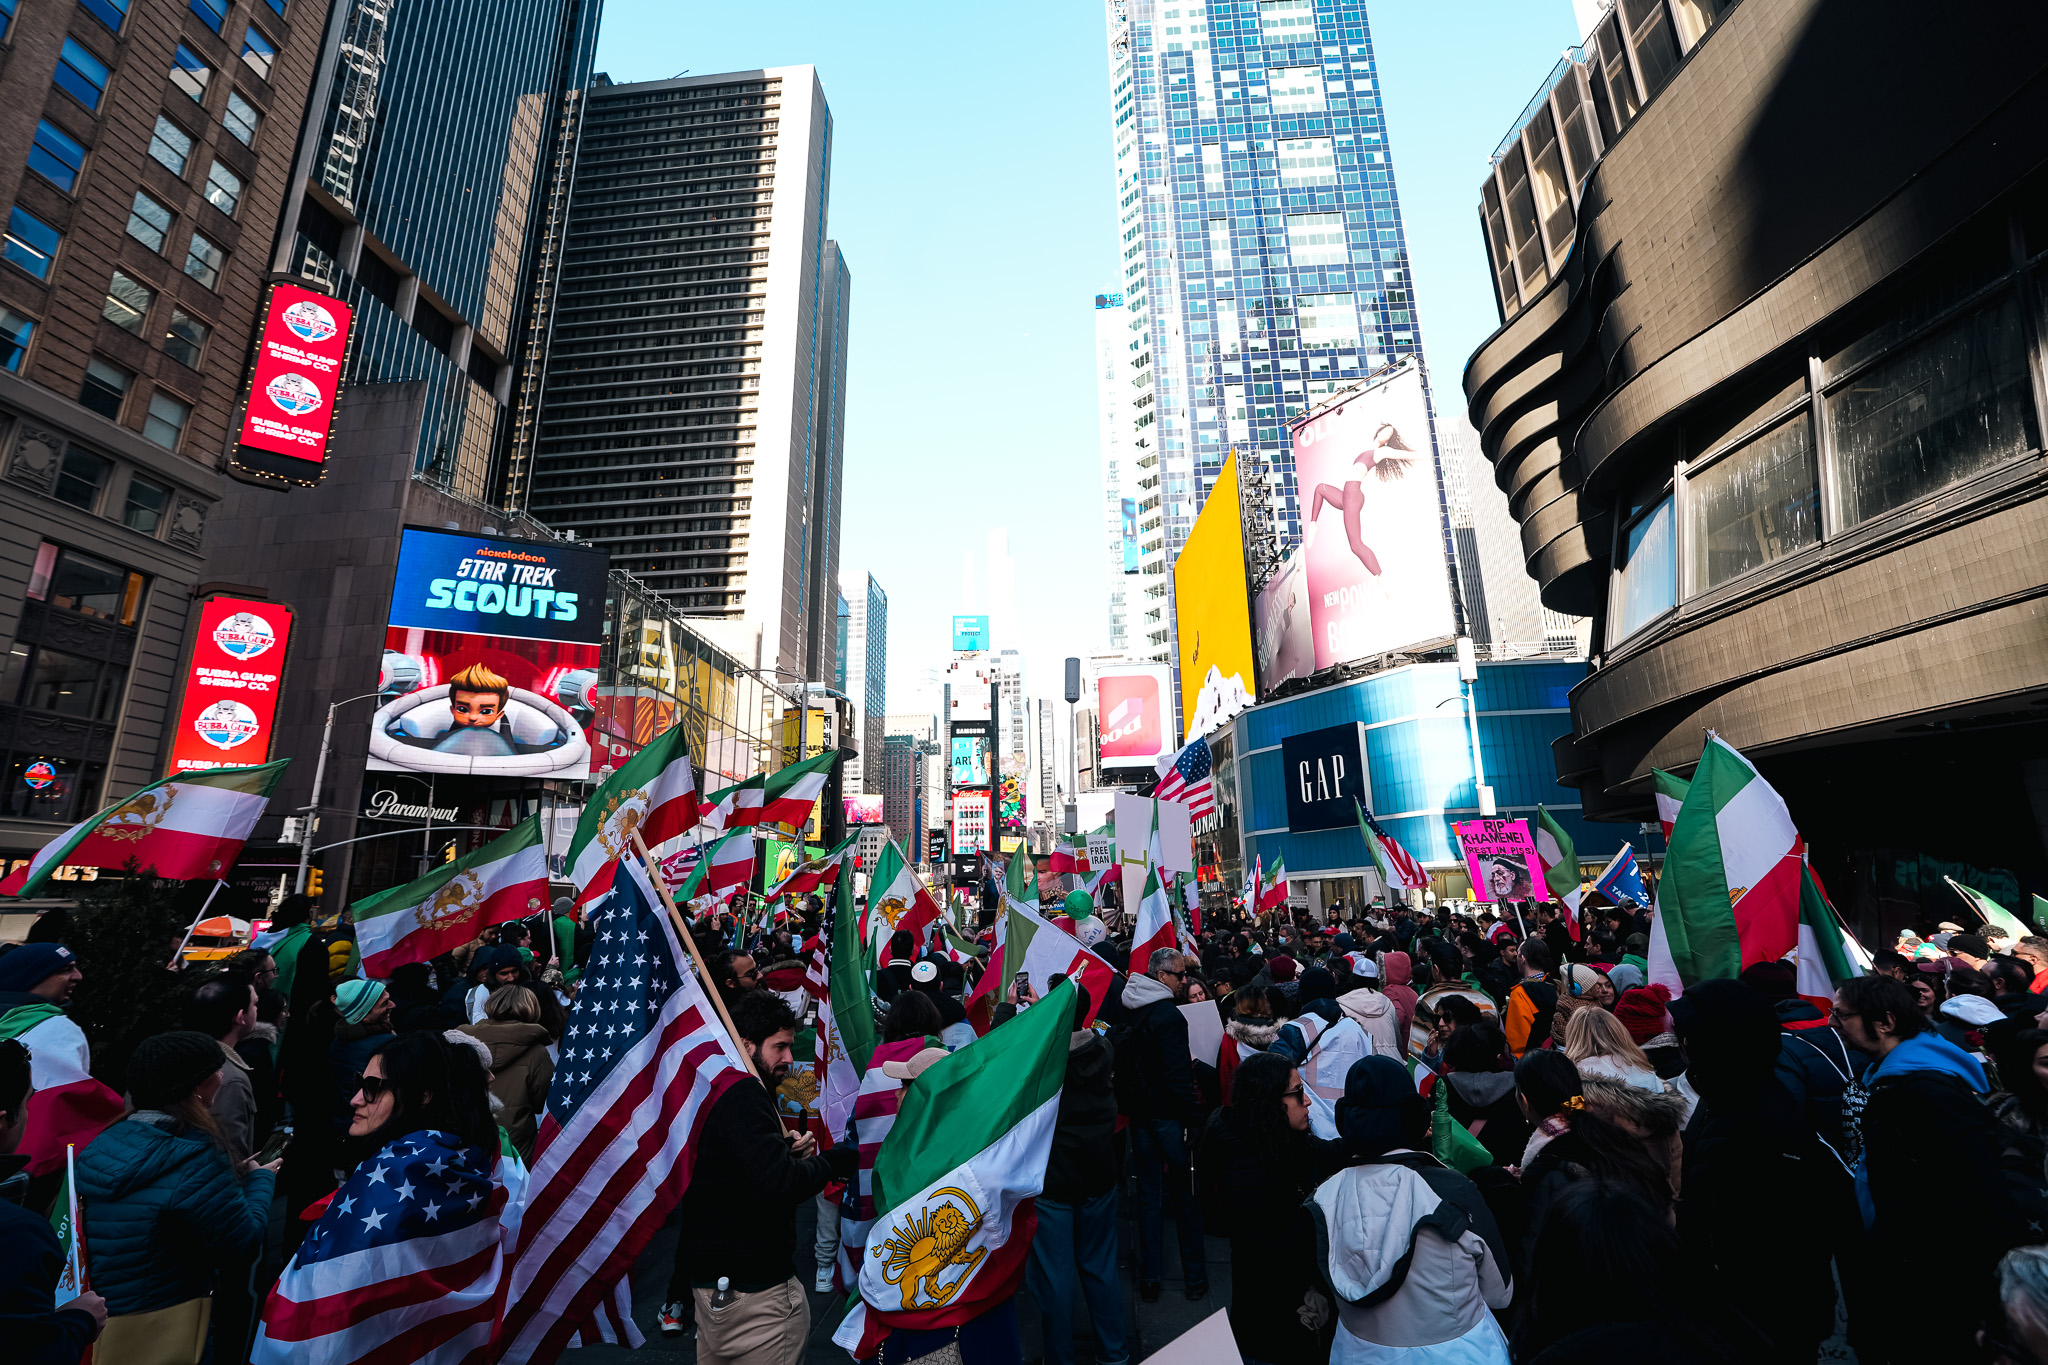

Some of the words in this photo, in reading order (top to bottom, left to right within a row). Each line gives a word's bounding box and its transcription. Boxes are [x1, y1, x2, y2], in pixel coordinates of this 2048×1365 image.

[267, 341, 306, 358] BUBBA
[306, 352, 338, 366] GUMP
[270, 350, 312, 366] SHRIMP
[312, 361, 333, 373] CO.
[250, 416, 290, 432] BUBBA
[290, 427, 324, 440] GUMP
[253, 425, 297, 441] SHRIMP
[297, 435, 318, 447] CO.
[476, 547, 546, 563] nickelodeon
[456, 557, 508, 583] STAR
[511, 564, 557, 588] TREK
[425, 578, 579, 622] SCOUTS
[1324, 589, 1340, 608] NEW
[216, 631, 245, 642] BUBBA
[247, 634, 273, 646] GUMP
[196, 667, 239, 680] BUBBA
[240, 672, 277, 683] GUMP
[199, 677, 247, 689] SHRIMP
[247, 681, 270, 692] CO.
[197, 721, 228, 731] BUBBA
[230, 723, 257, 734] GUMP
[955, 727, 986, 735] SAMSUNG
[177, 759, 222, 770] BUBBA
[1299, 754, 1345, 803] GAP
[958, 789, 984, 798] Coca-Cola
[365, 789, 460, 823] Paramount
[1484, 820, 1505, 833] RIP
[1461, 832, 1525, 846] KHAMENEI
[1090, 846, 1109, 855] FREE
[1465, 846, 1491, 855] (REST
[1496, 846, 1507, 854] IN
[1091, 855, 1110, 864] IRAN
